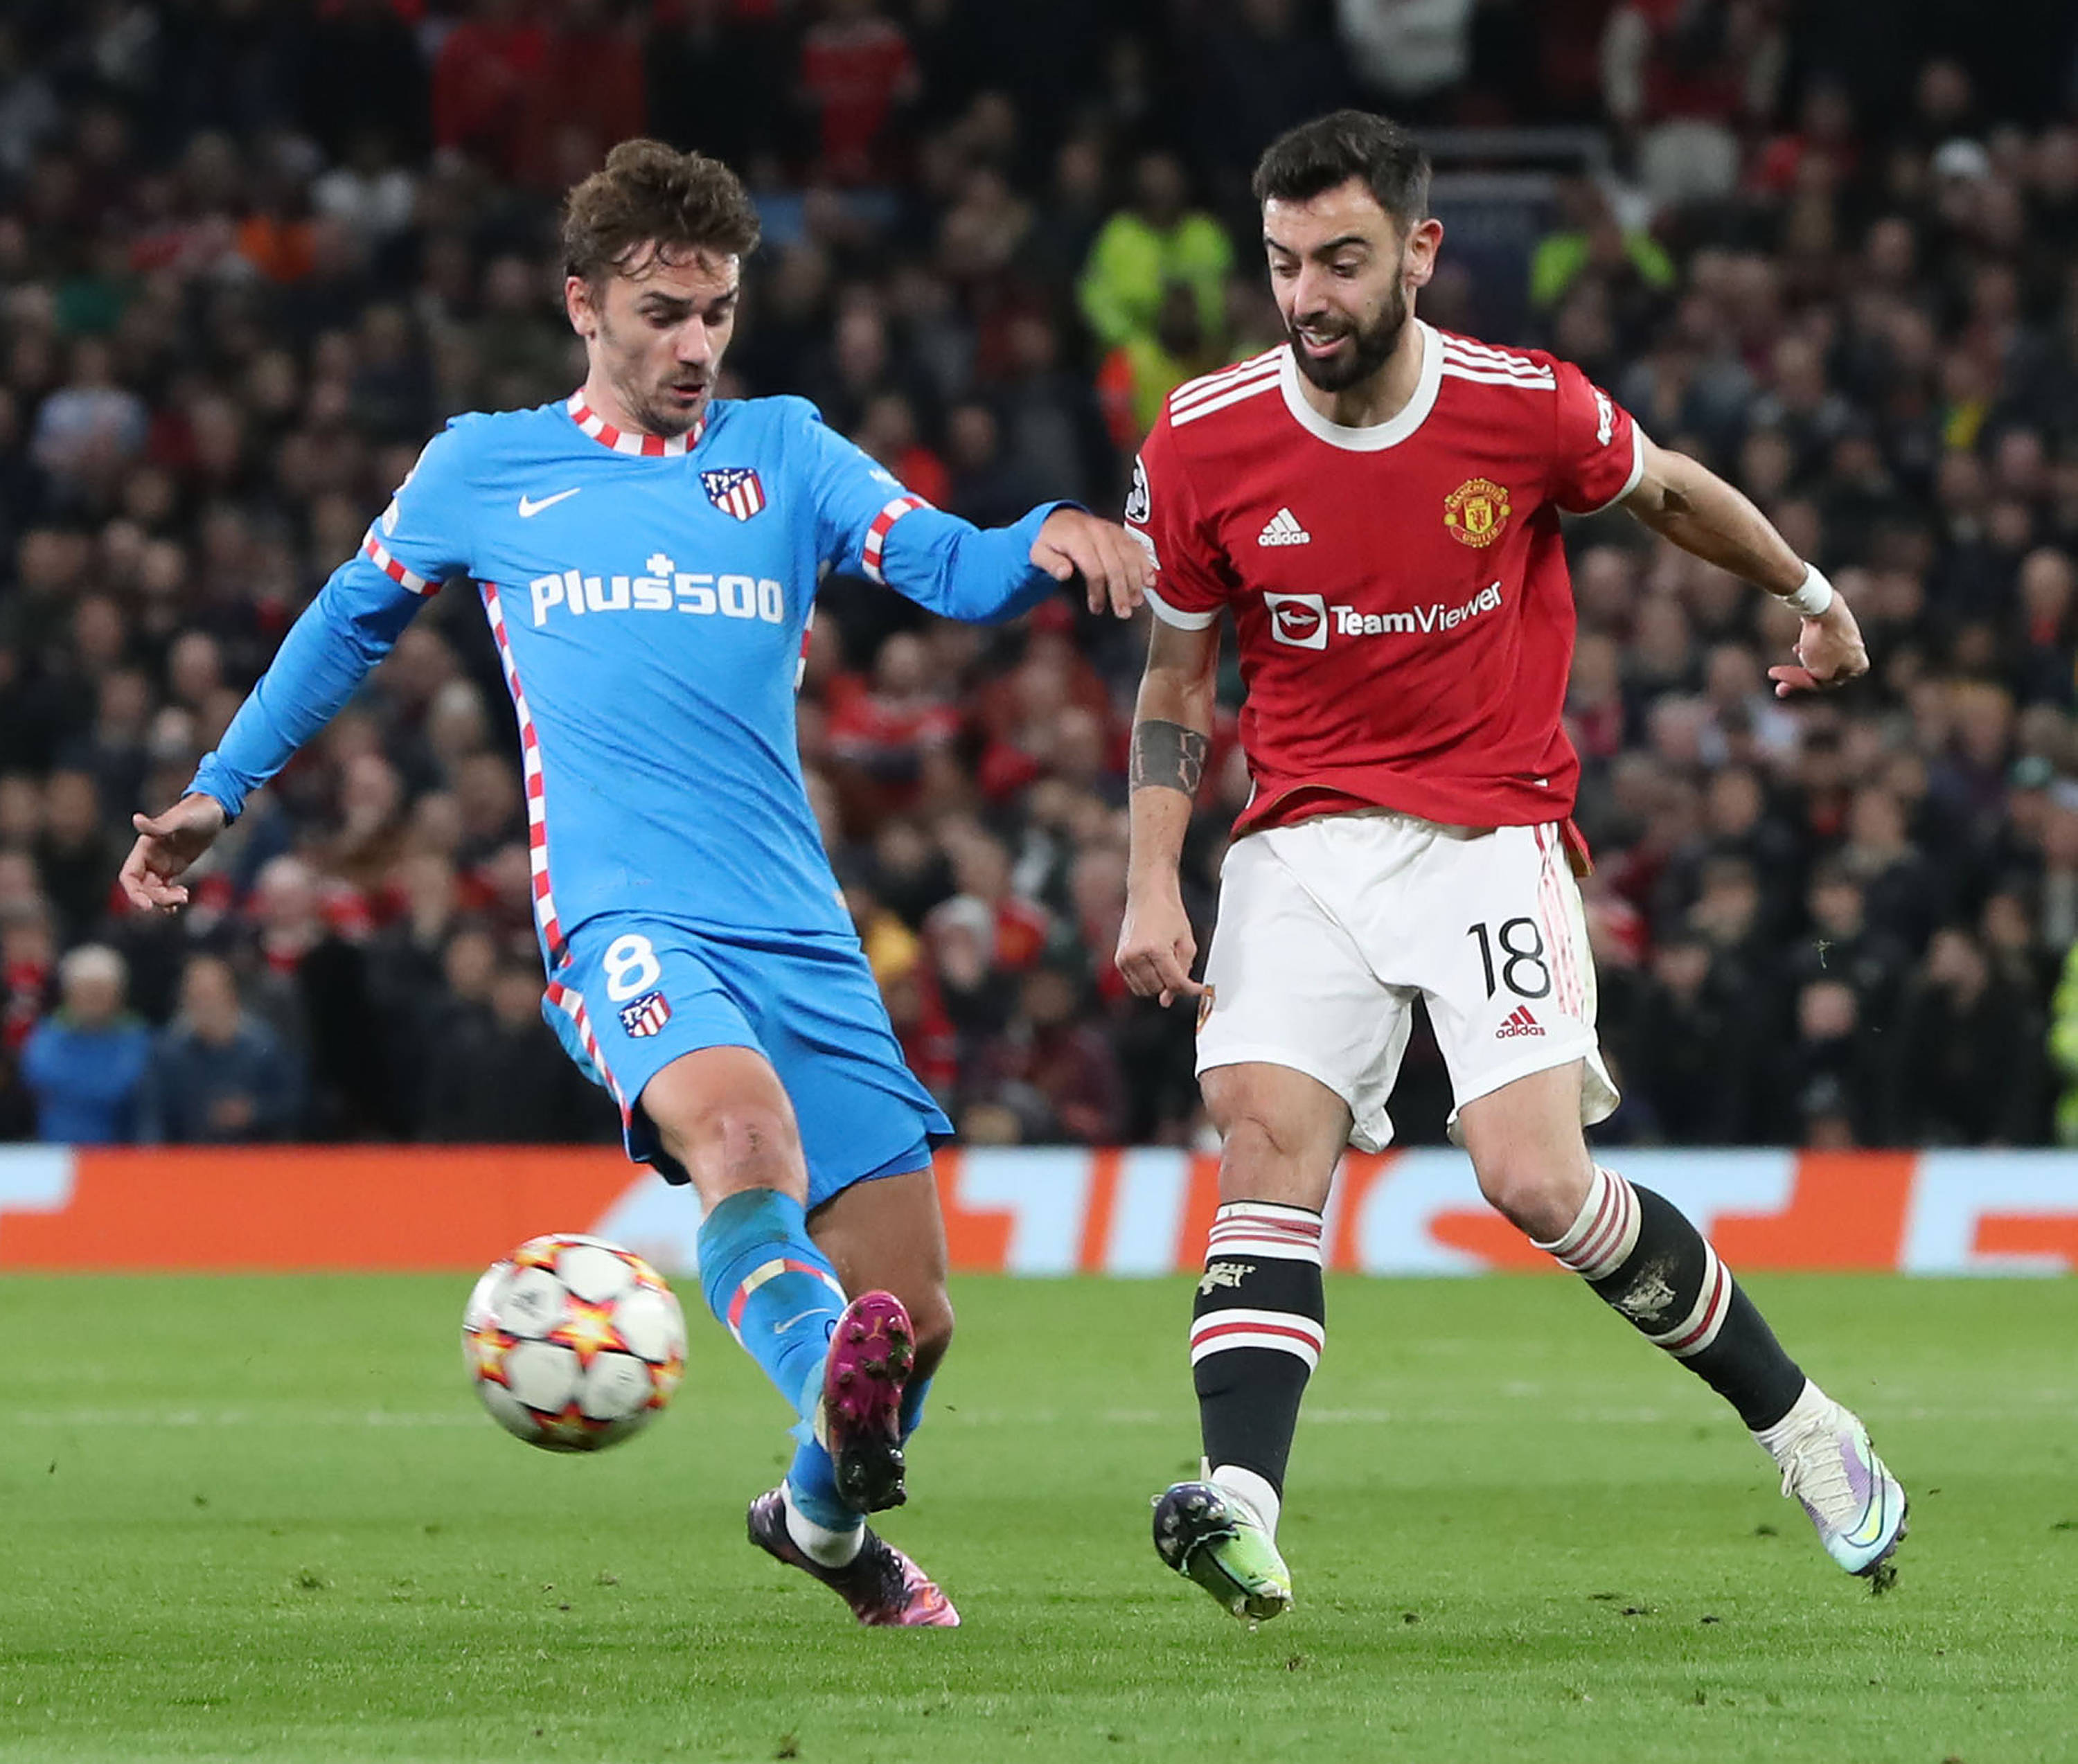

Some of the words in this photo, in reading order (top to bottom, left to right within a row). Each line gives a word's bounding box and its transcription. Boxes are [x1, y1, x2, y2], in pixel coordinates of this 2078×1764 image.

[1258, 531, 1311, 546] adidas
[530, 553, 783, 627] Plus500
[1329, 580, 1502, 636] TeamViewer
[603, 934, 661, 1002] 8
[1466, 917, 1550, 1001] 18
[1495, 1024, 1545, 1039] adidas
